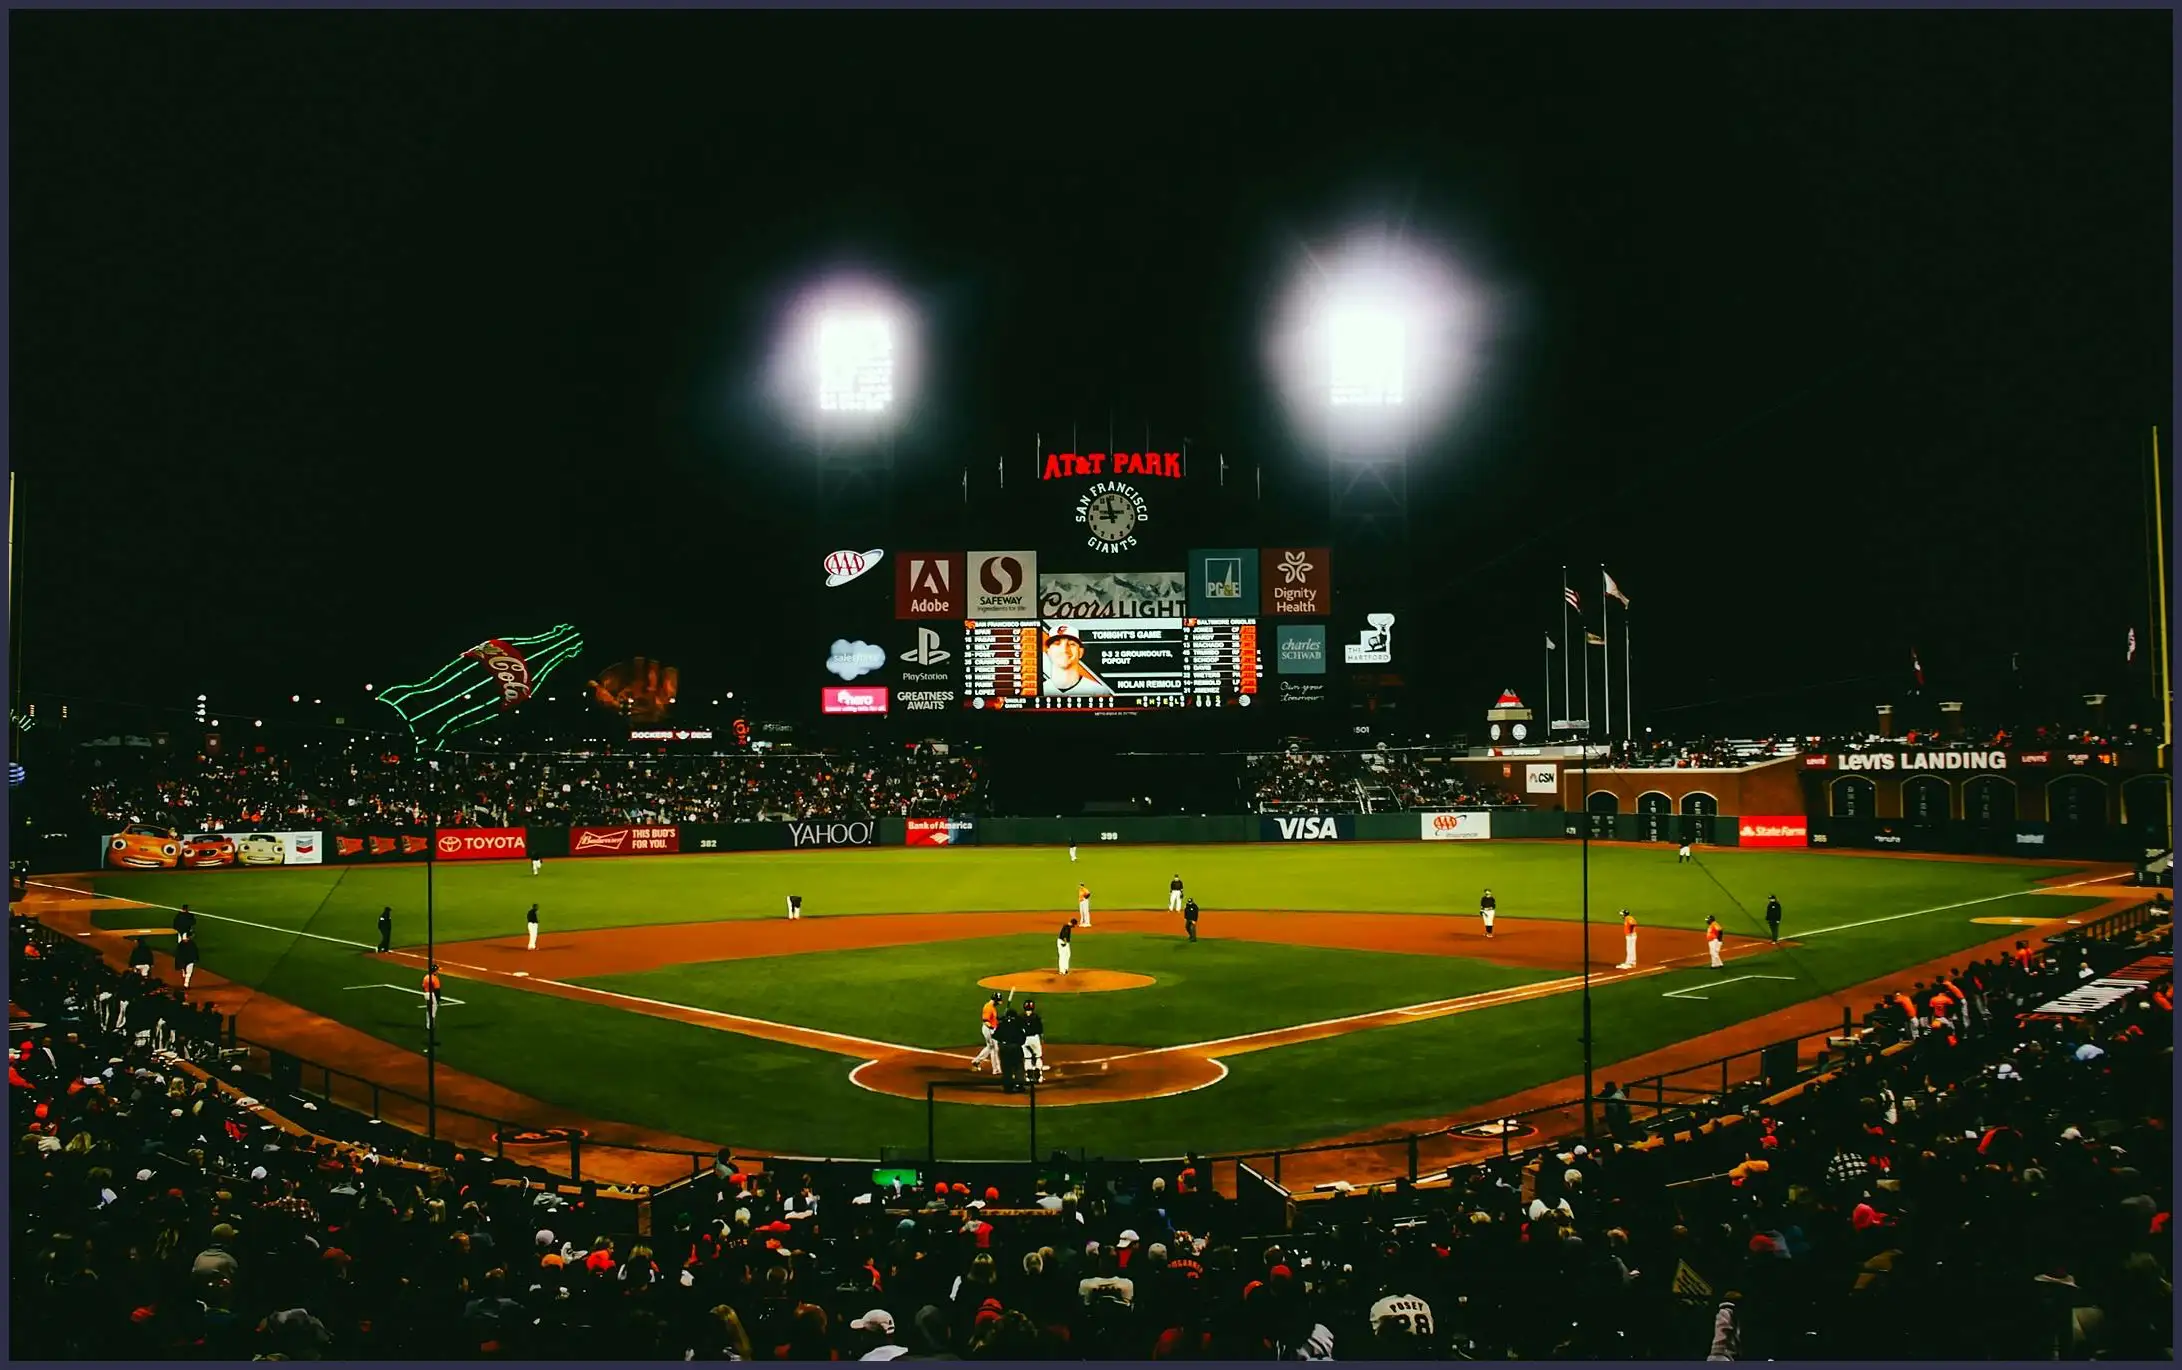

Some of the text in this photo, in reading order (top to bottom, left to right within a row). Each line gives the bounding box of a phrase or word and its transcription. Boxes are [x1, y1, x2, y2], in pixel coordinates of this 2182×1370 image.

[1043, 452, 1182, 480] AT&T PARK
[1075, 481, 1148, 523] SAN FRANCISCO
[1087, 536, 1137, 554] GIANTS
[1274, 587, 1317, 601] Dignity
[911, 600, 949, 612] Adobe
[980, 596, 1023, 605] SAFEWAY
[1039, 592, 1188, 618] Coors LIGHT
[1276, 601, 1316, 613] Health
[1137, 631, 1162, 639] GAME
[1281, 638, 1321, 650] charles
[1281, 651, 1321, 660] SCHWAB
[488, 656, 531, 702] Cola
[902, 672, 948, 682] PlayStation
[1117, 680, 1145, 688] NOLAN
[897, 691, 954, 701] GREATNESS
[907, 701, 945, 710] AWAITS
[1901, 751, 2007, 769] LANDING
[1538, 773, 1554, 783] CSN
[908, 821, 973, 830] Bank of America
[1273, 817, 1338, 840] VISA
[1755, 826, 1807, 836] State Farm
[632, 829, 676, 838] THIS BUD'S
[789, 821, 874, 847] YAHOO!
[464, 836, 526, 849] TOYOTA
[632, 839, 667, 849] FOR YOU.
[1389, 1301, 1424, 1313] POSEY
